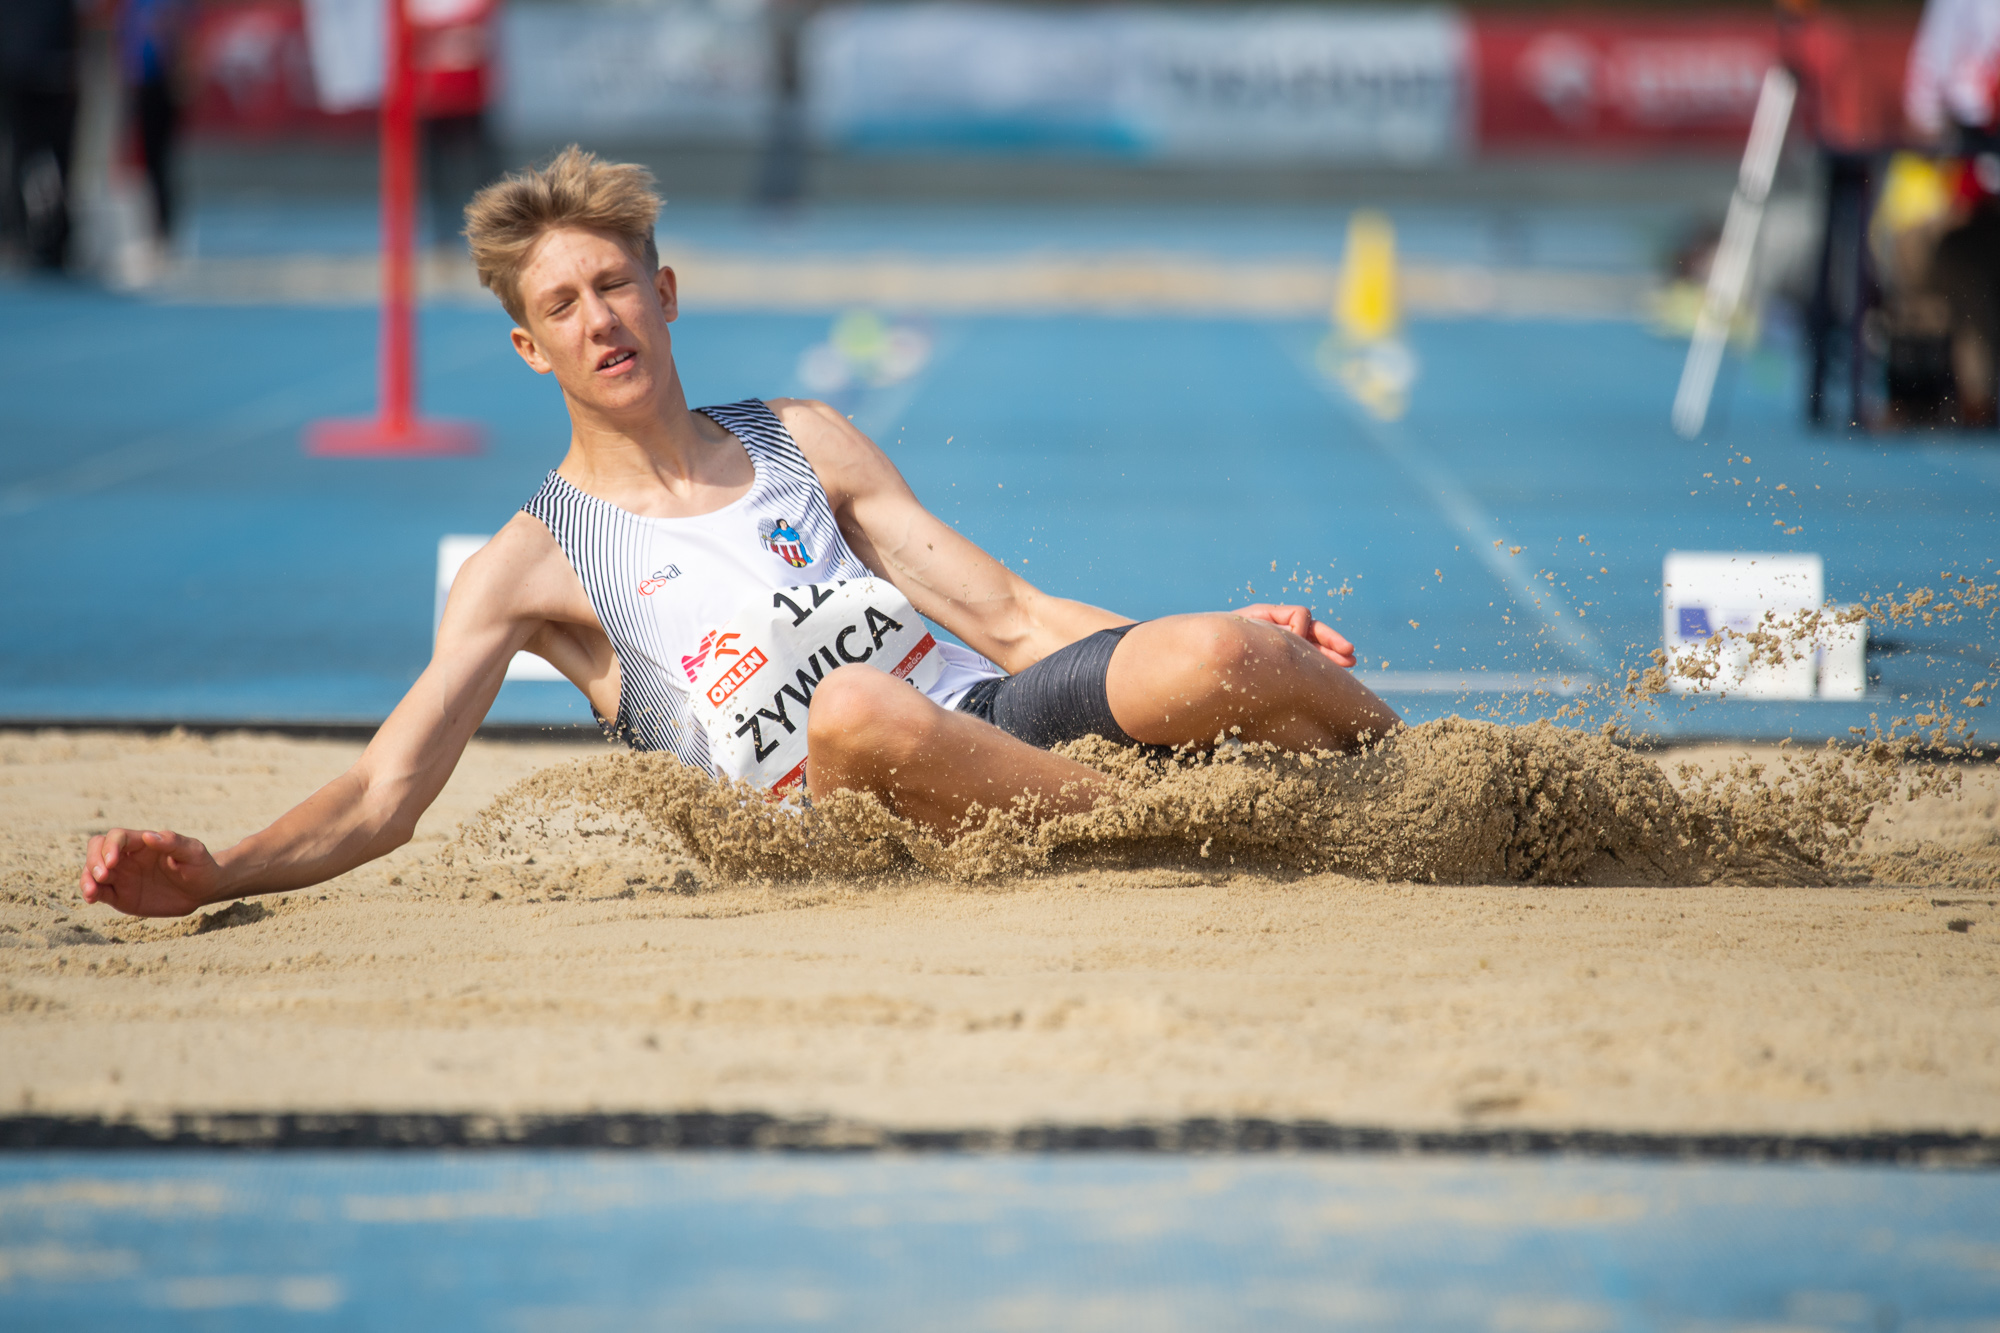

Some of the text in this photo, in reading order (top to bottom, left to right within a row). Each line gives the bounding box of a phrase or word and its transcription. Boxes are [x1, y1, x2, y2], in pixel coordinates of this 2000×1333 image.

[773, 580, 847, 628] 12
[711, 651, 764, 703] ORLEN
[735, 606, 904, 764] ŻYWICA
